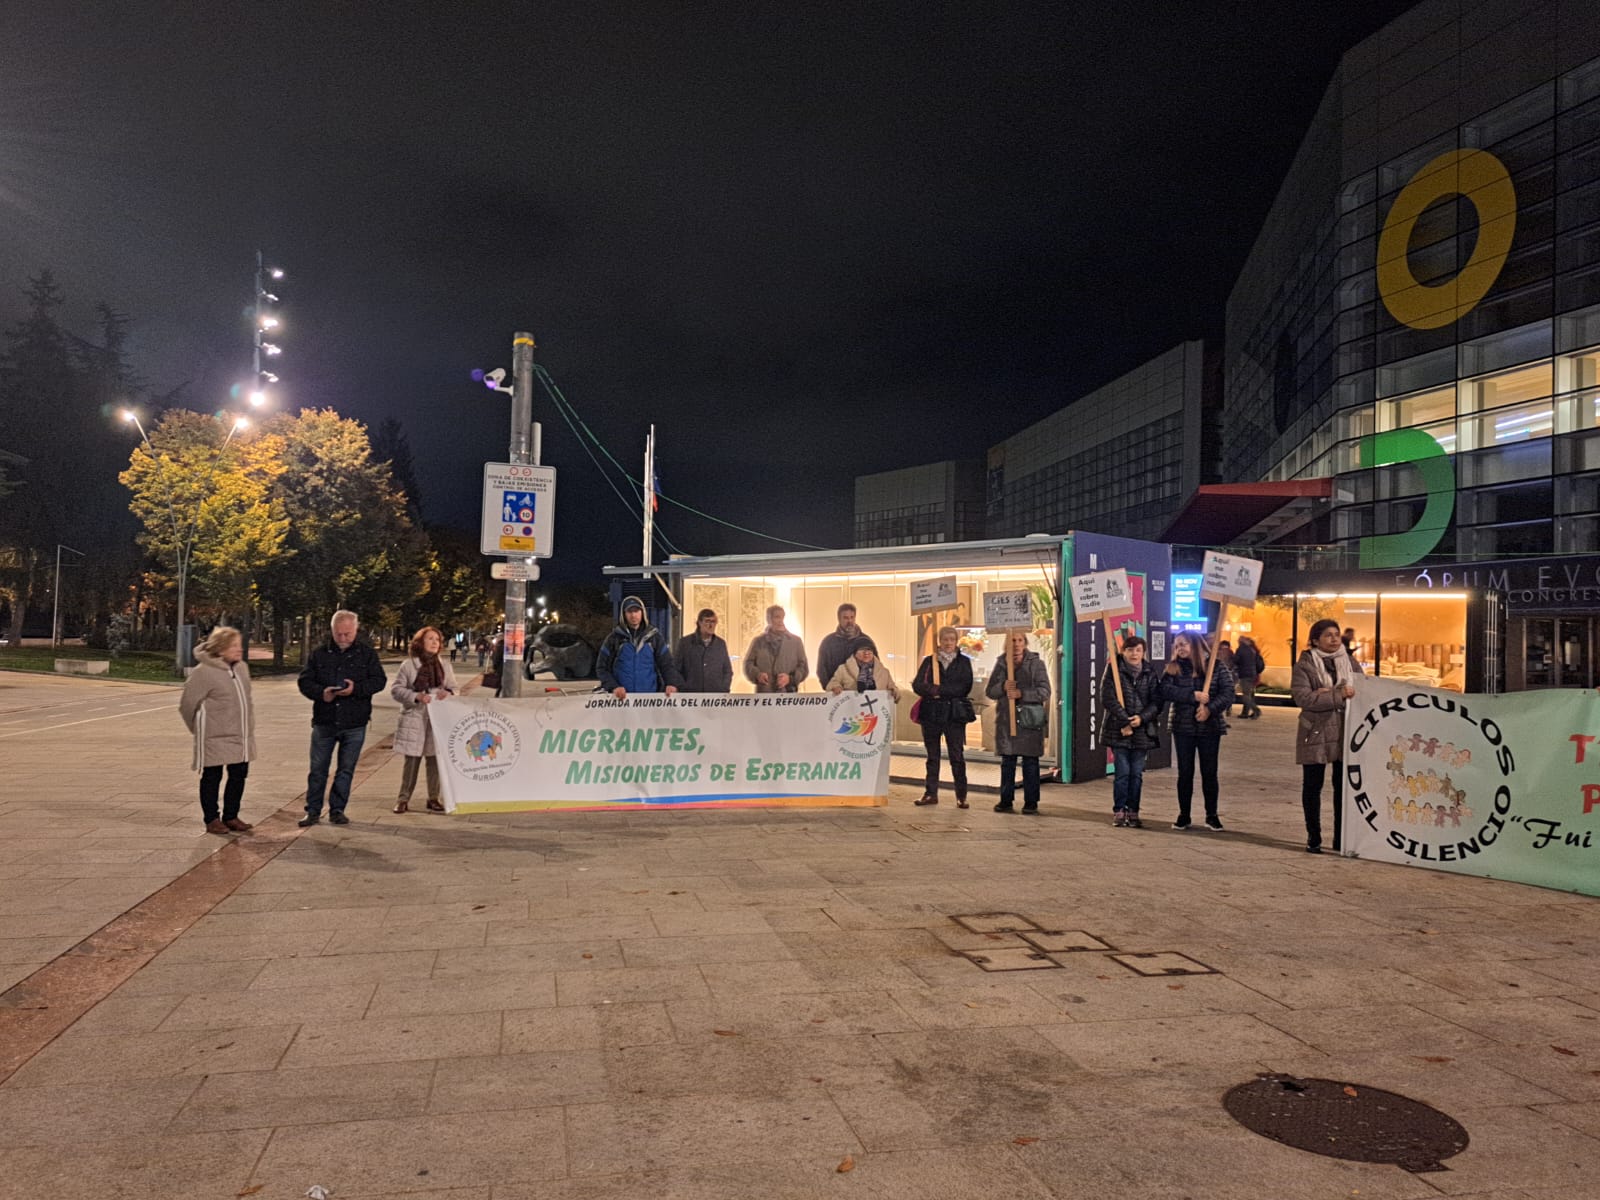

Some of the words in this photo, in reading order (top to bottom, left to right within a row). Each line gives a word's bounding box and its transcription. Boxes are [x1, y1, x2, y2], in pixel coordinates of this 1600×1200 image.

[585, 698, 630, 709] JORNADA
[633, 698, 677, 708] MUNDIAL
[681, 698, 698, 707] DEL
[701, 697, 751, 707] MIGRANTE
[753, 698, 760, 706] Y
[762, 698, 773, 706] EL
[775, 697, 828, 706] REFUGIADO
[538, 727, 705, 755] MIGRANTES,
[1350, 692, 1515, 777] CIRCULOS
[839, 747, 879, 759] PEREGRINOS
[472, 769, 505, 781] BURGOS
[565, 759, 702, 785] MISIONEROS
[710, 763, 736, 782] DE
[746, 758, 862, 781] ESPERANZA
[1347, 764, 1379, 833] DEL
[1386, 785, 1512, 862] SILENCIO
